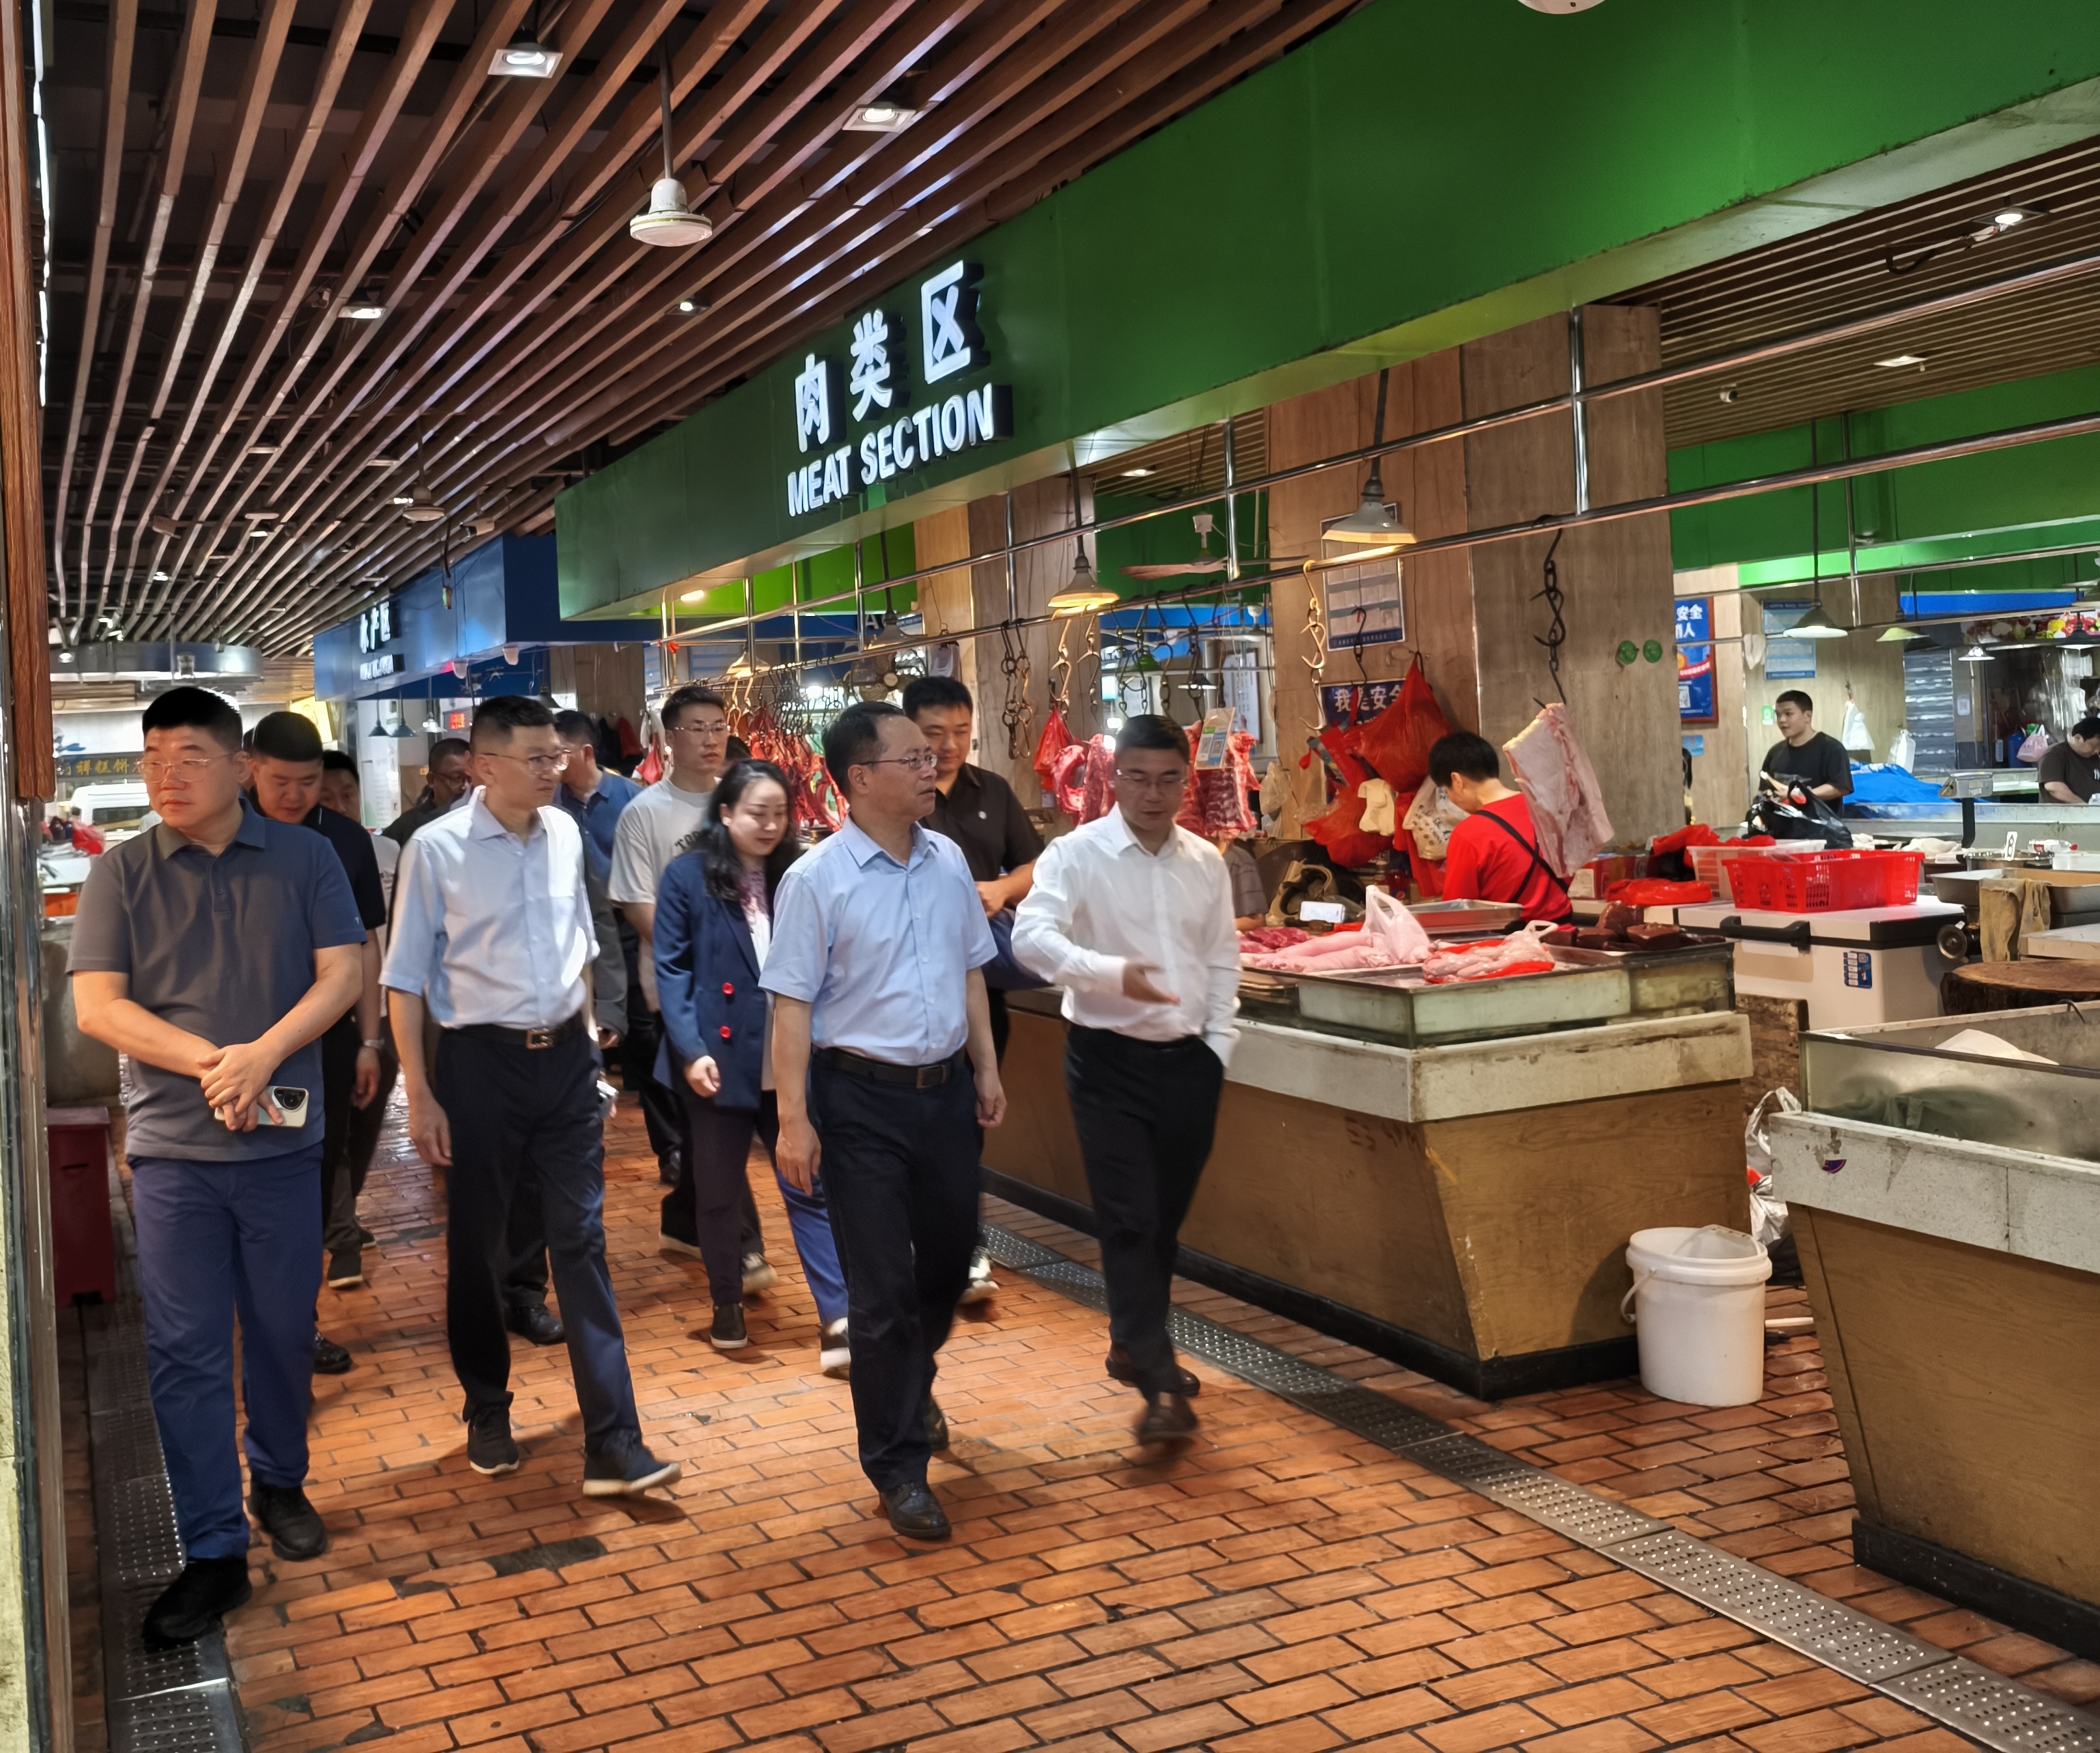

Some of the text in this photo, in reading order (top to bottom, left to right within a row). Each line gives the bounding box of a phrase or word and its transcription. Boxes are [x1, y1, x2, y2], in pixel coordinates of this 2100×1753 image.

[795, 260, 971, 453] 肉类区
[787, 383, 995, 517] MEAT SECTION
[1677, 604, 1703, 621] 安全
